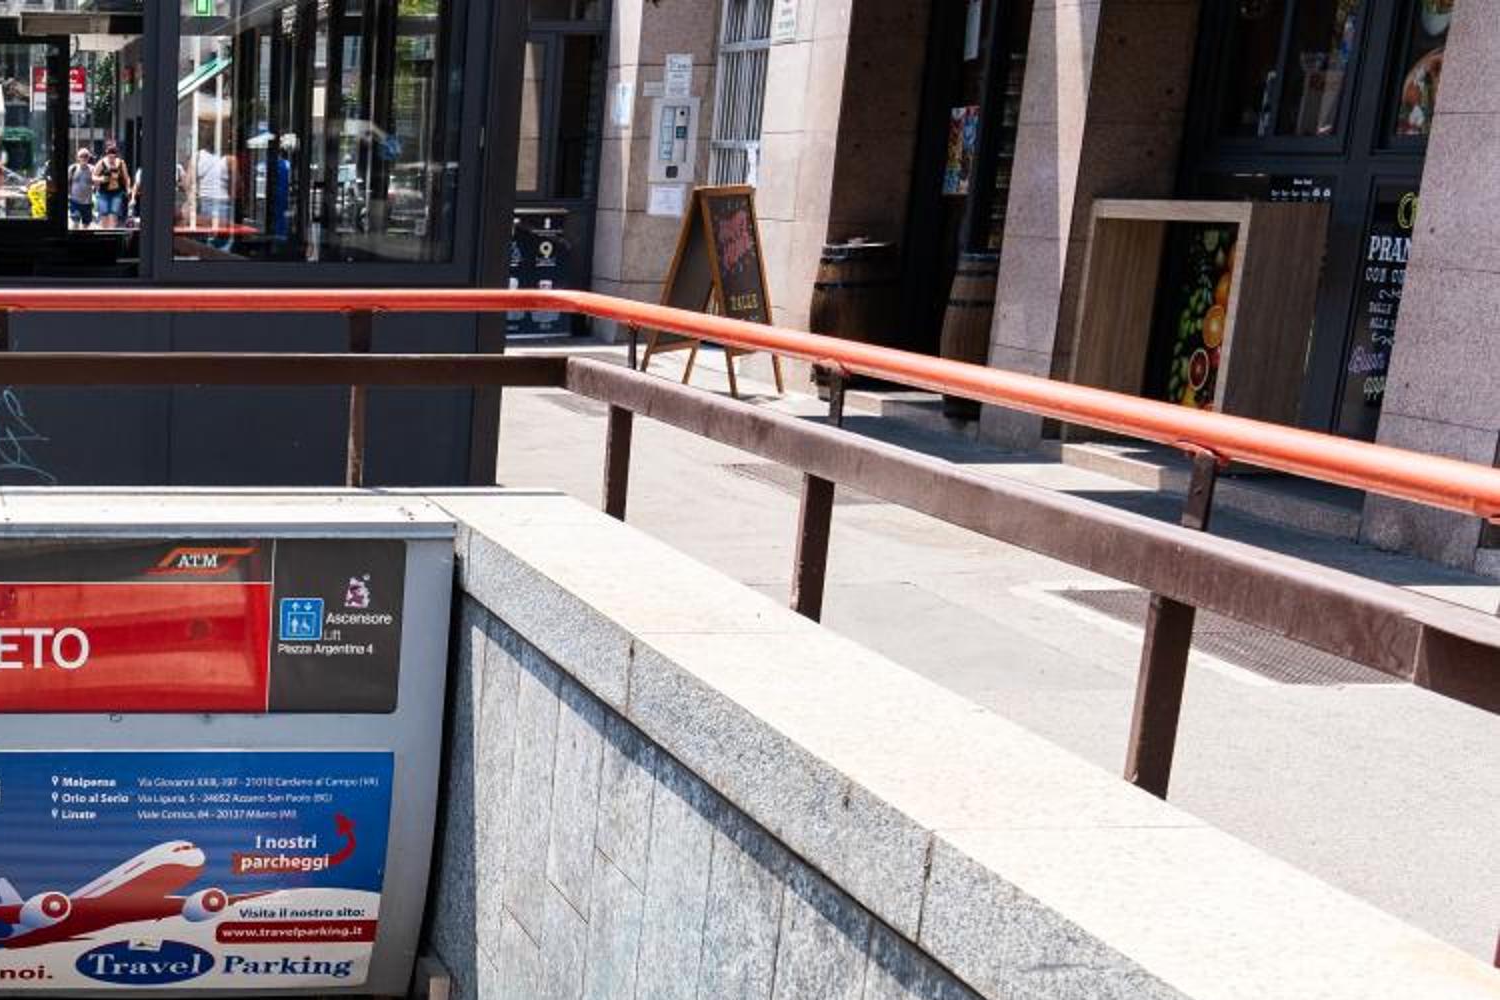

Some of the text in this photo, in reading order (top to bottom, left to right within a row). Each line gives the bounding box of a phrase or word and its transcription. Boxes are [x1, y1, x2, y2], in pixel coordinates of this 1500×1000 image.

[177, 553, 219, 569] ATM
[325, 612, 393, 626] Ascensore
[323, 629, 342, 642] Lift
[277, 643, 374, 656] Piazza Argentina 4
[61, 777, 117, 788] Malpensa
[137, 777, 153, 788] Via
[153, 777, 195, 788] Giovanni
[61, 792, 130, 804] Orio al Serio
[137, 793, 153, 804] Via
[61, 809, 97, 820] Linate
[265, 834, 318, 850] nostri
[240, 854, 330, 871] parcheggi
[238, 906, 366, 919] Visita il nostro sito:
[221, 924, 364, 940] www.travelparking.it
[0, 964, 53, 980] noi.
[86, 952, 354, 979] Travel Parking
